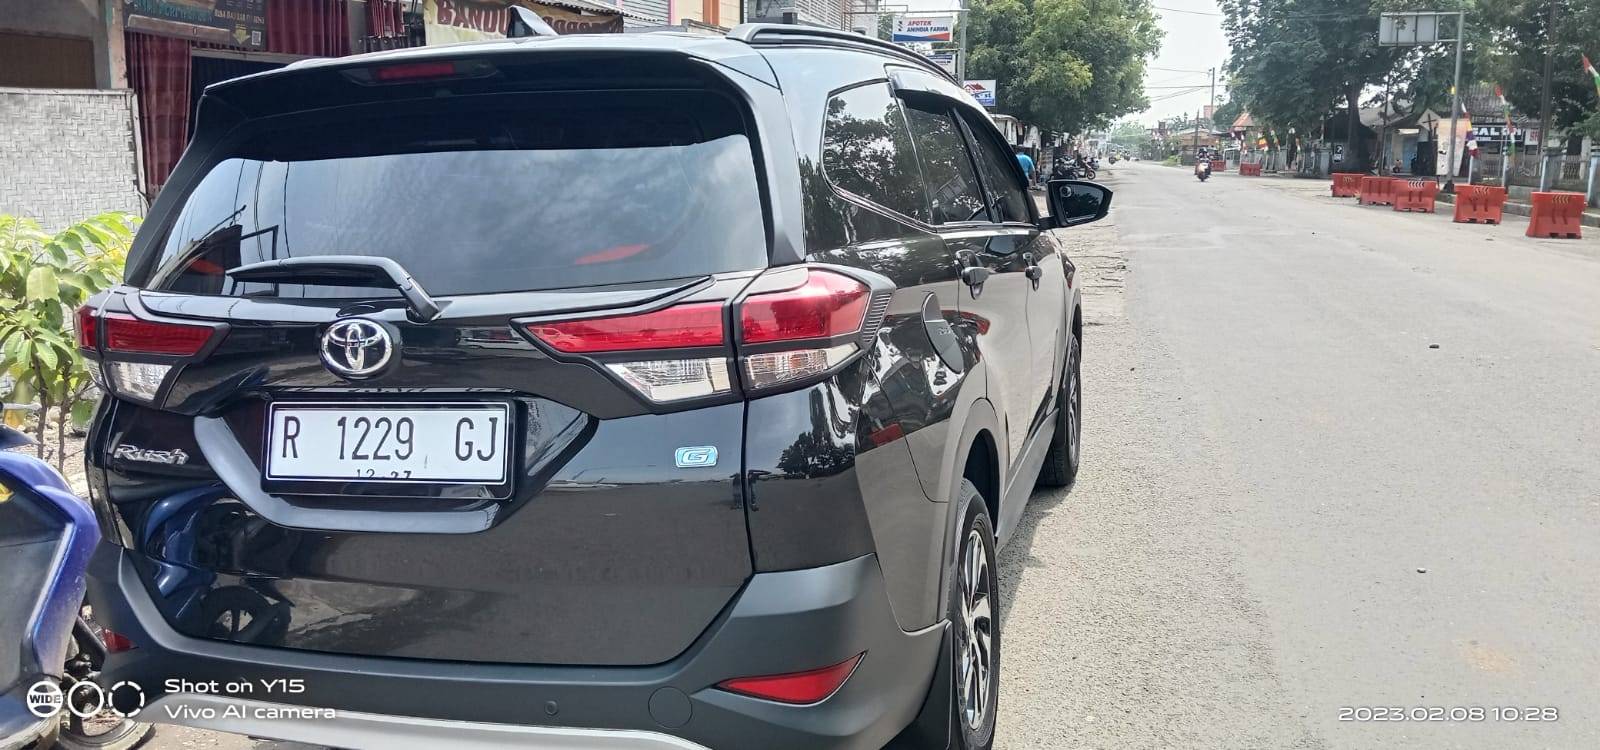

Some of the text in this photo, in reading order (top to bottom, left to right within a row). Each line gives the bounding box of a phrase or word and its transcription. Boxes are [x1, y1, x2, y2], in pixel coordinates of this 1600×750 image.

[113, 444, 190, 465] Rush
[281, 416, 499, 462] R 1229 GJ
